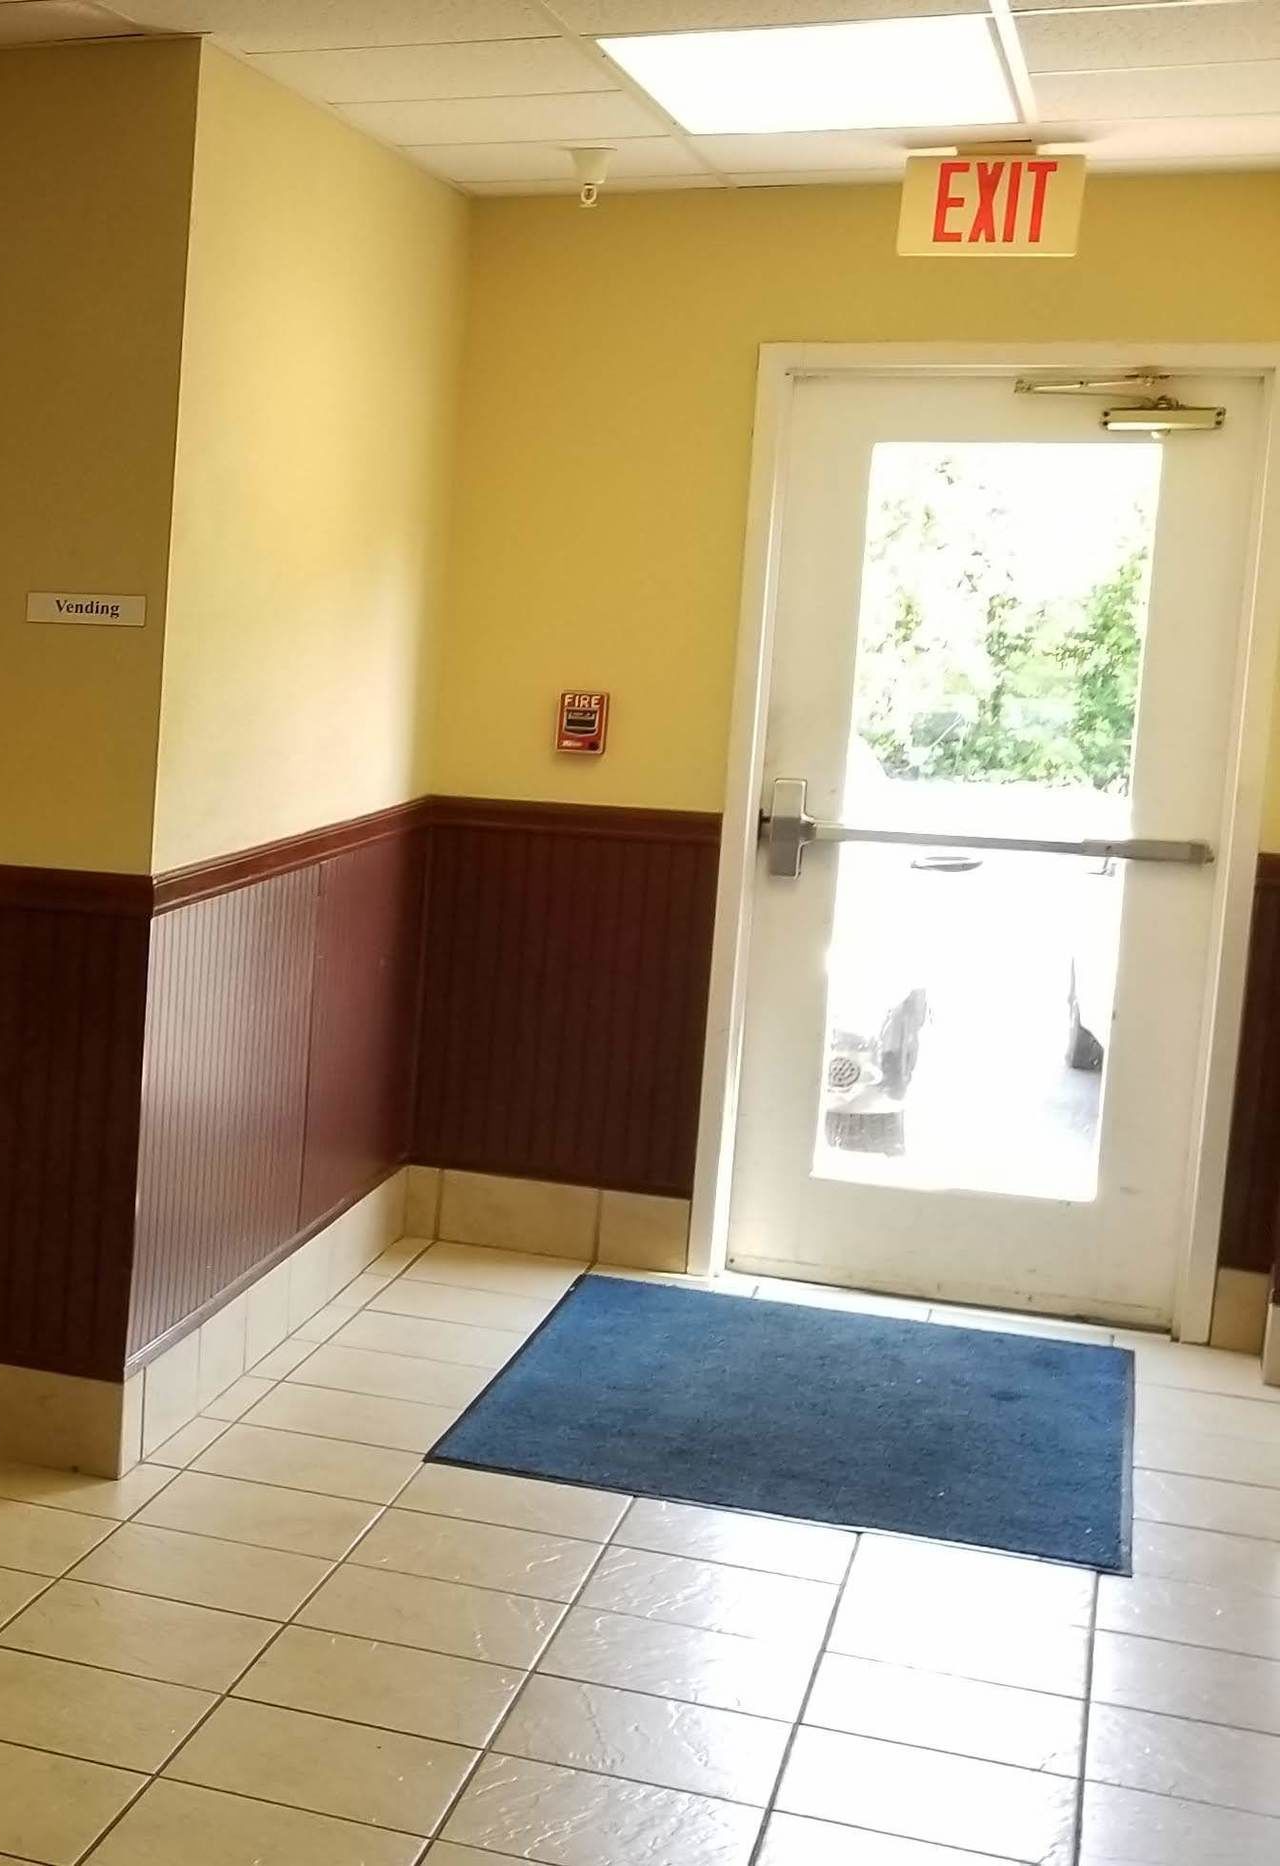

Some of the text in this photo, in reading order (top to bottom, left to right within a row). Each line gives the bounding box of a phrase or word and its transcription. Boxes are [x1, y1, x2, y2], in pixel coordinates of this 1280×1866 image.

[932, 161, 1058, 243] EXIT
[56, 599, 120, 619] Vending
[564, 694, 602, 708] FIRE
